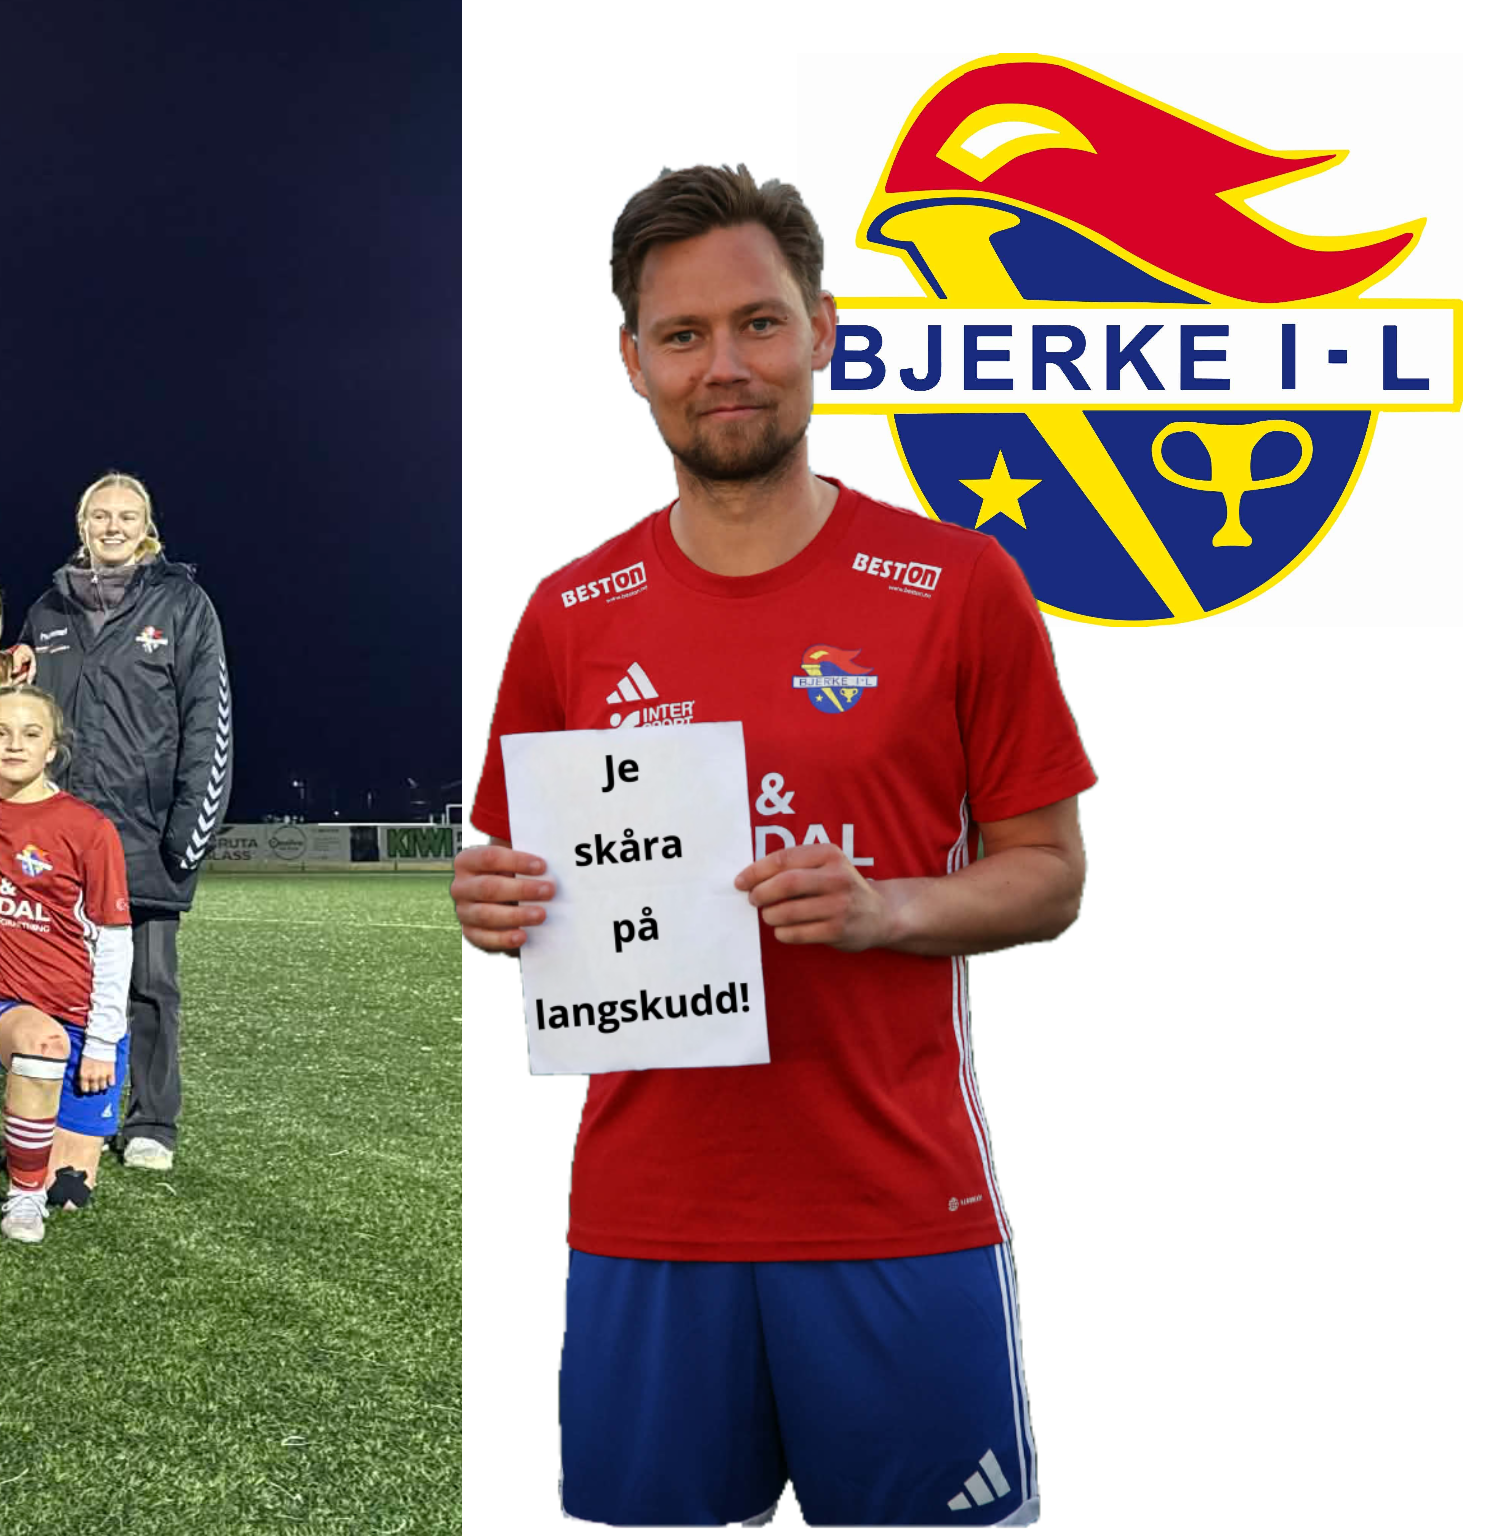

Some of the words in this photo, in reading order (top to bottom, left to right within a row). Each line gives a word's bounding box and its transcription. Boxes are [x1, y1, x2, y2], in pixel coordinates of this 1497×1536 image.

[643, 701, 692, 723] INTER
[602, 755, 639, 793] Je
[755, 772, 796, 816] &
[217, 838, 258, 849] RUTA
[387, 827, 453, 858] KIWI
[574, 828, 683, 866] skåra
[755, 823, 875, 867] DAL
[0, 877, 16, 896] &
[613, 906, 659, 953] på
[535, 982, 750, 1034] langskudd!
